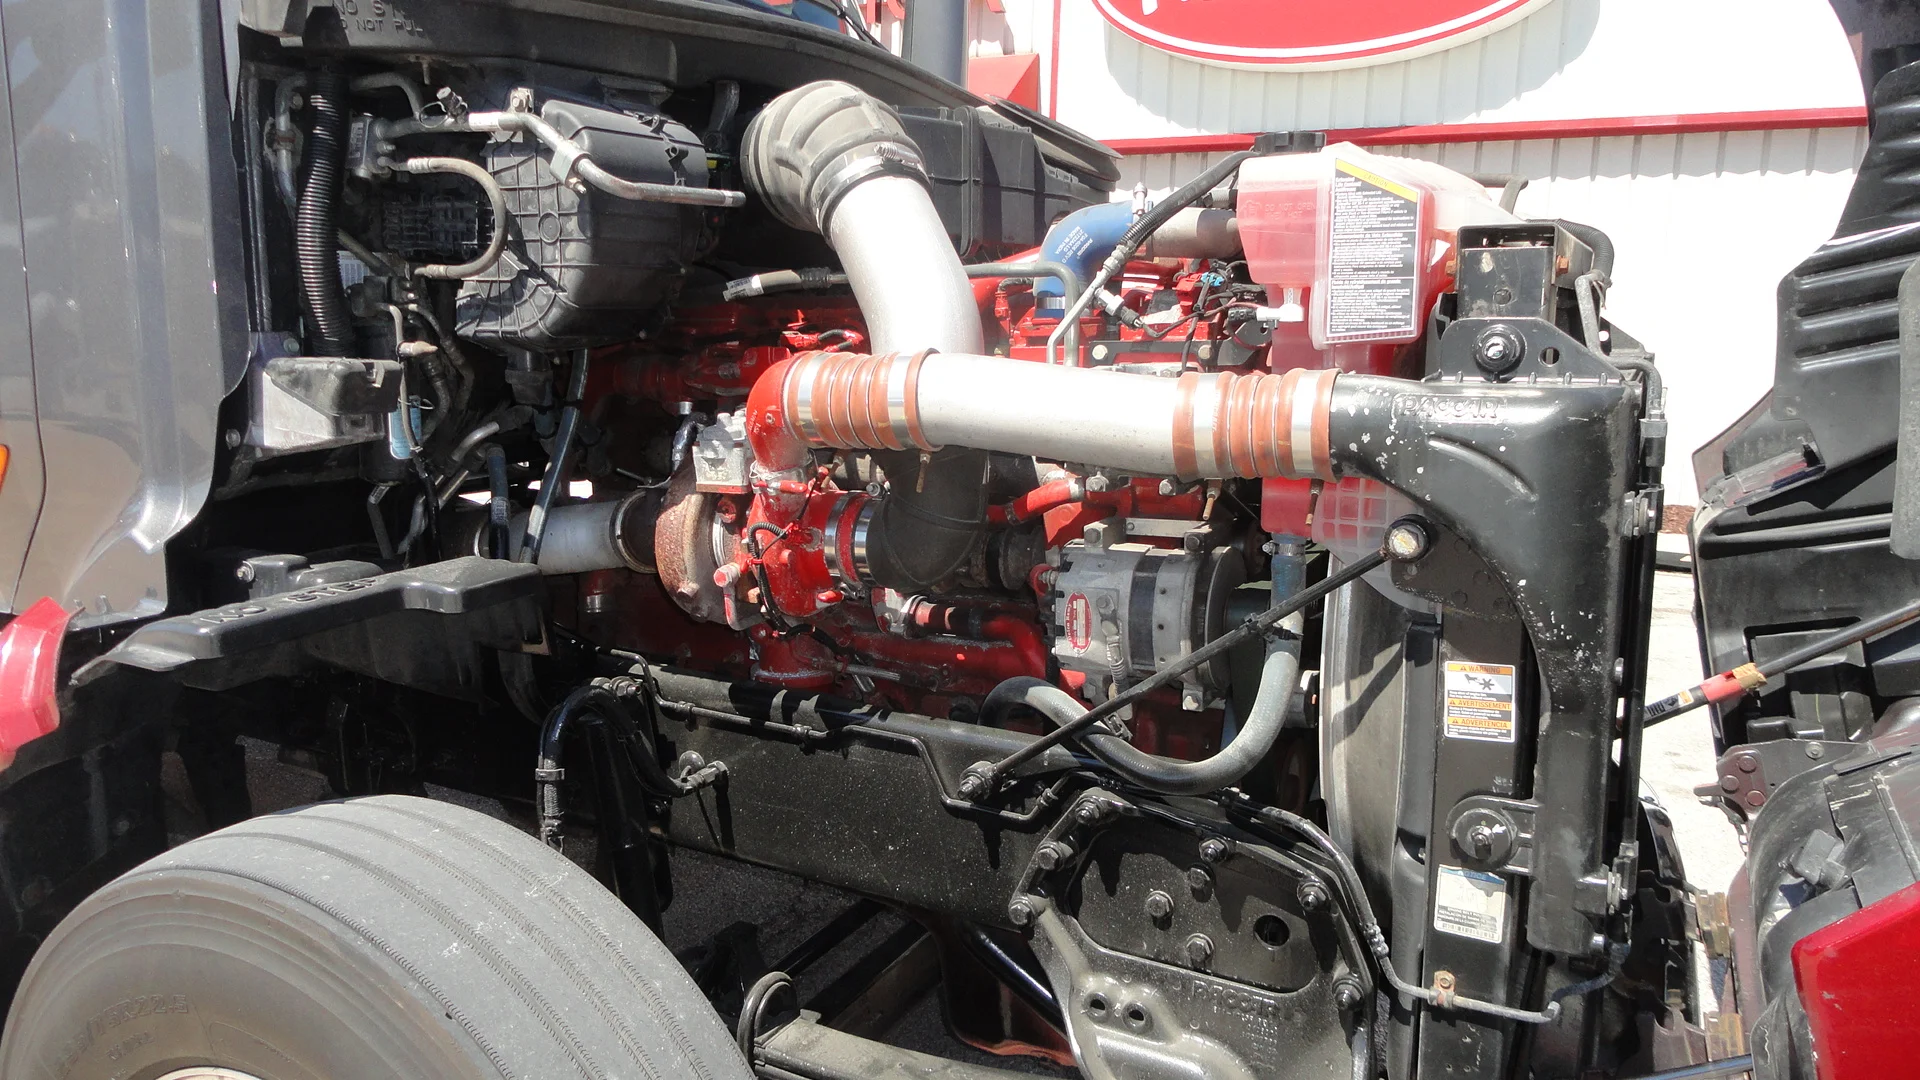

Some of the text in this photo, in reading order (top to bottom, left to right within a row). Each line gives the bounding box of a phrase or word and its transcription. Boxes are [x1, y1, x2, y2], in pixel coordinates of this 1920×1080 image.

[356, 18, 384, 32] NOT
[1362, 172, 1388, 187] CAUTION
[1399, 396, 1498, 418] PACCAR
[1468, 665, 1500, 673] WARNING
[1458, 700, 1510, 709] AVERTISSEMENT
[1461, 719, 1507, 727] ADVERTENCIA
